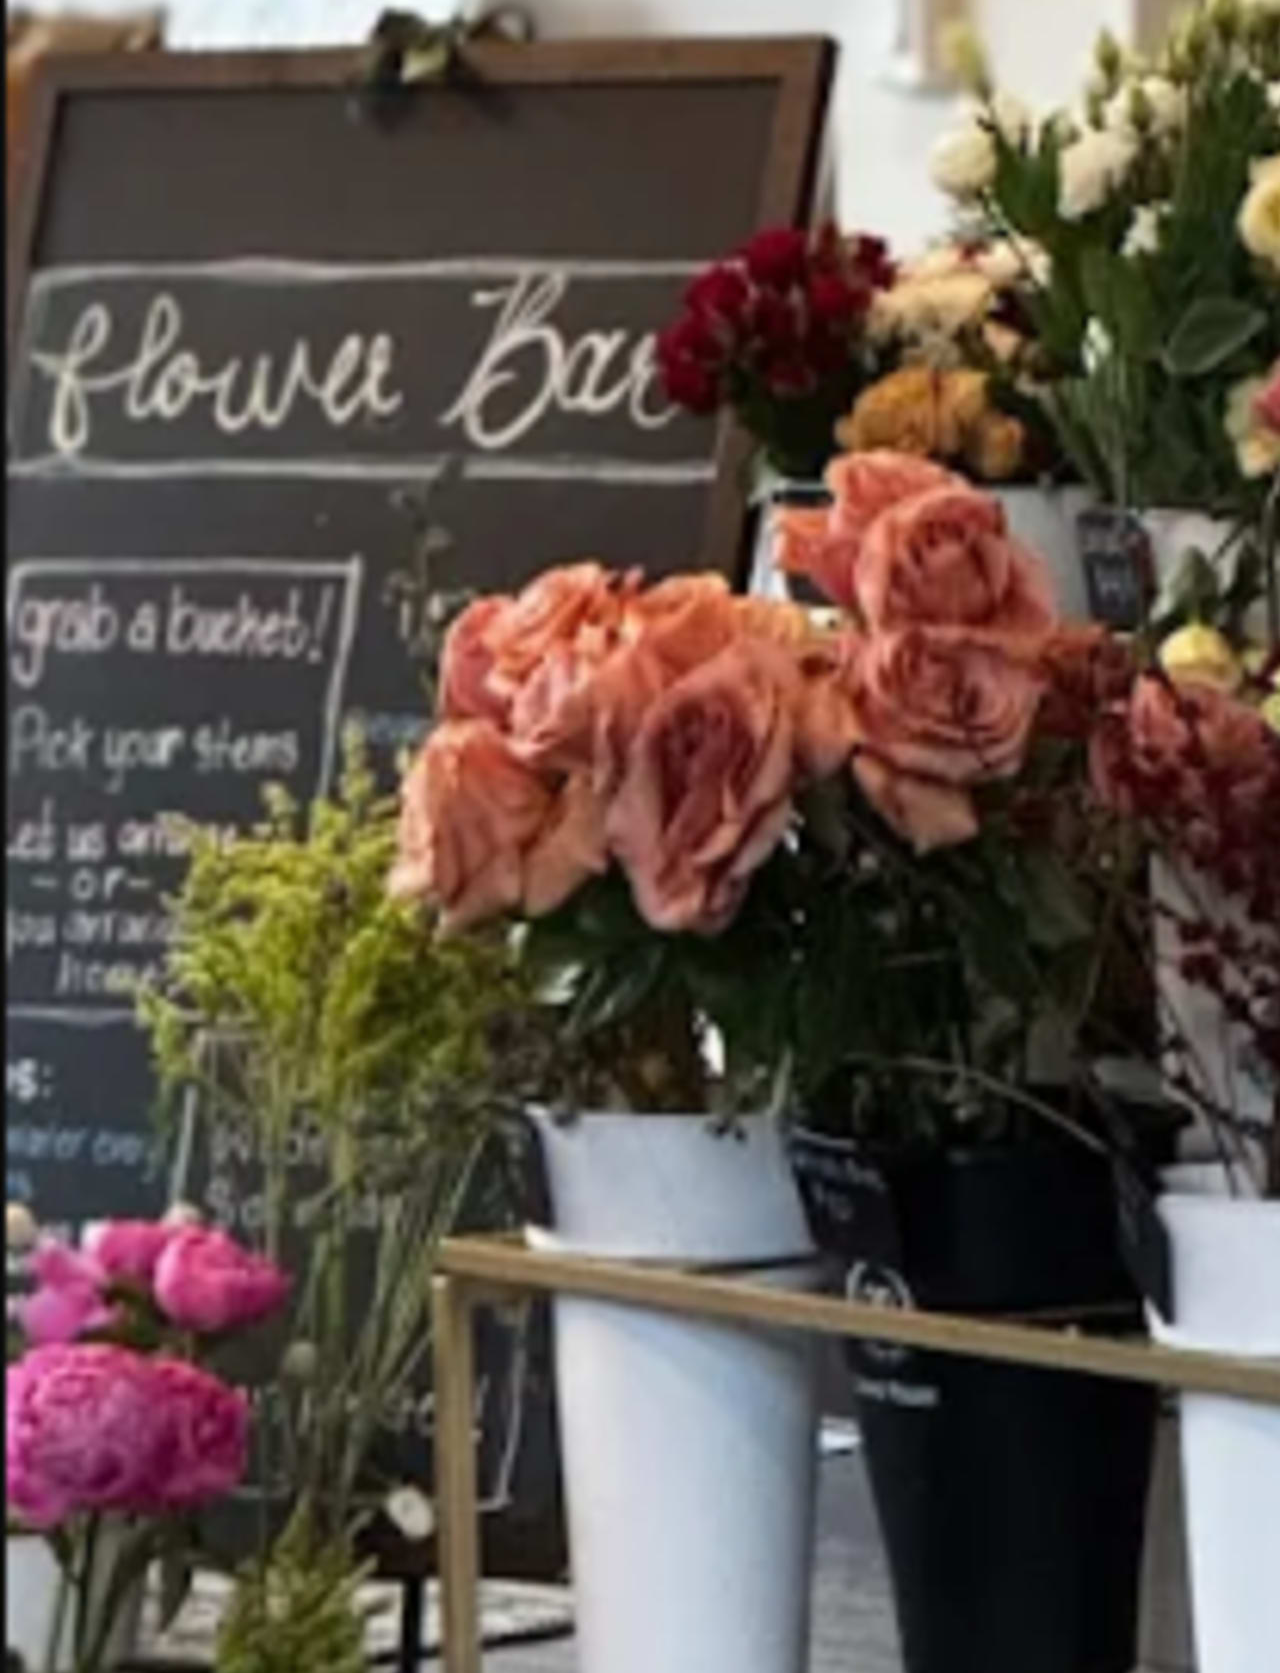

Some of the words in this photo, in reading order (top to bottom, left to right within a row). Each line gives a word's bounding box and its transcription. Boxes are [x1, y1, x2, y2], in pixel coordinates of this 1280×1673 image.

[31, 293, 402, 455] flower
[439, 268, 681, 449] Bar
[10, 583, 119, 689] grab
[129, 600, 156, 651] a
[103, 724, 184, 794] your
